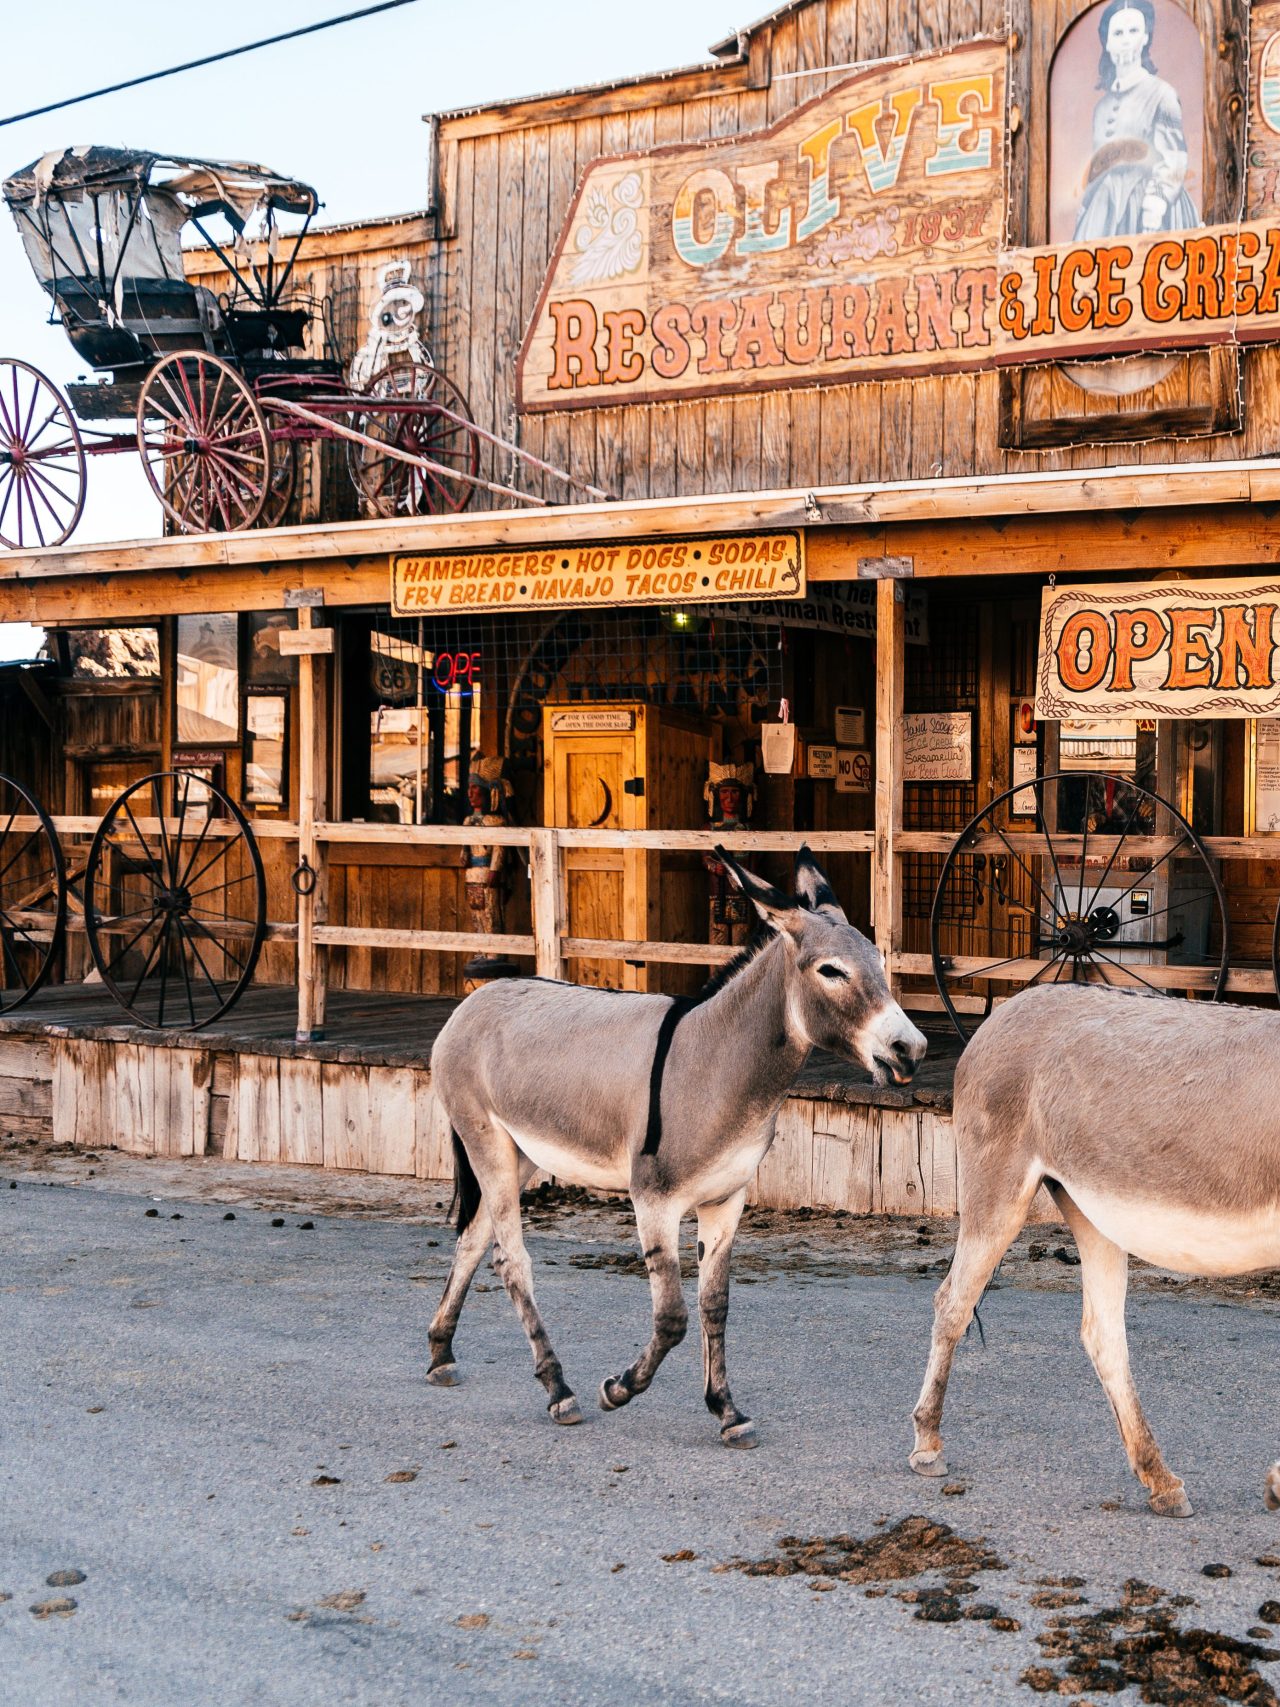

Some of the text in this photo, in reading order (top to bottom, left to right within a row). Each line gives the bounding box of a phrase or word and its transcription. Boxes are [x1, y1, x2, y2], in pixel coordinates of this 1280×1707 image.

[671, 73, 994, 268] OLIVE
[902, 203, 990, 247] 1837
[999, 271, 1026, 340] &
[1031, 245, 1133, 336] ICE
[547, 266, 997, 389] RESTAURANT
[403, 540, 787, 582] HAMBURGERS HOT DOGS SODAS
[403, 567, 777, 606] FRY BREAD NAVAJO TACOS CHILI
[1055, 603, 1279, 692] OPEN
[379, 669, 406, 689] 66
[839, 760, 851, 775] NO
[905, 751, 963, 764] Sarsaparilla
